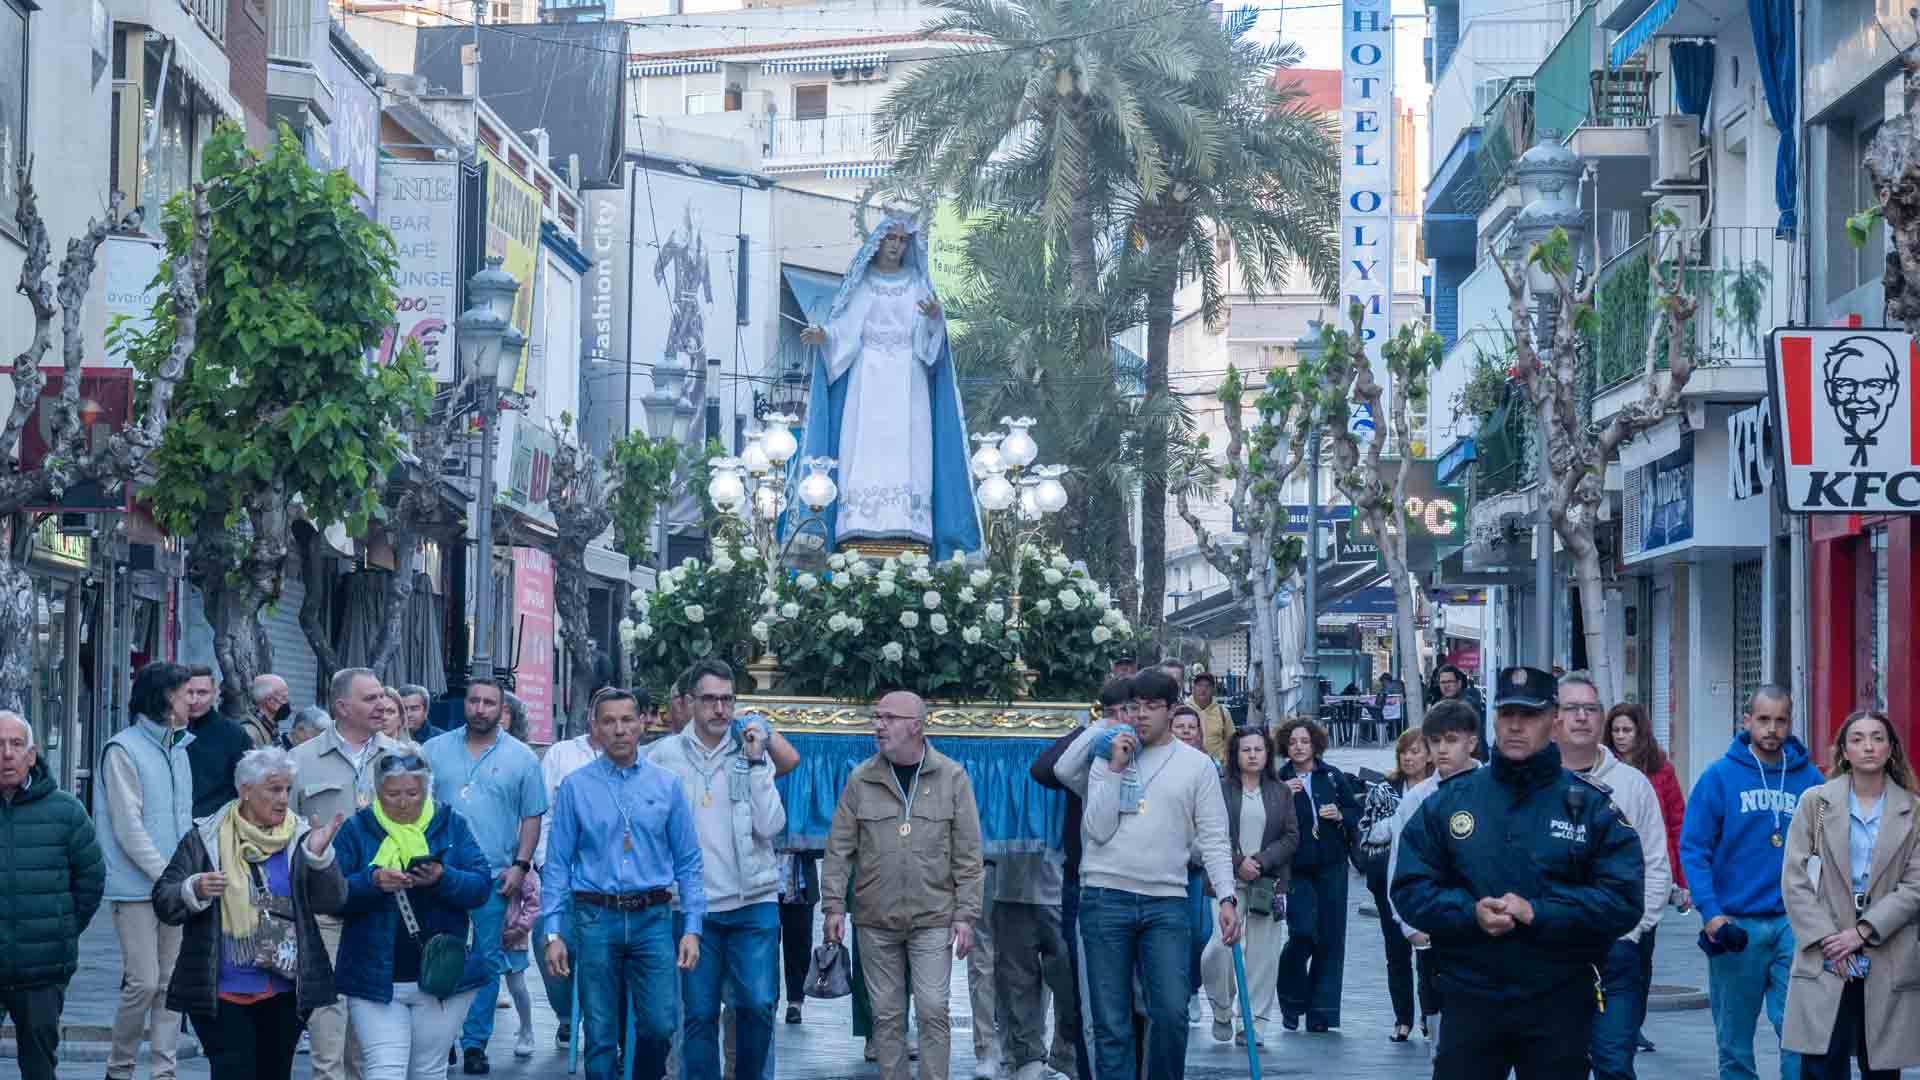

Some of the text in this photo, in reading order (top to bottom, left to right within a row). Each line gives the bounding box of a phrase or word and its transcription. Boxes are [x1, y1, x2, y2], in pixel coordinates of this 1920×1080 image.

[1350, 10, 1382, 167] HOTEL
[390, 215, 432, 233] BAR
[594, 199, 616, 252] City
[1349, 190, 1383, 418] OLYMPA
[1802, 470, 1920, 508] KFC
